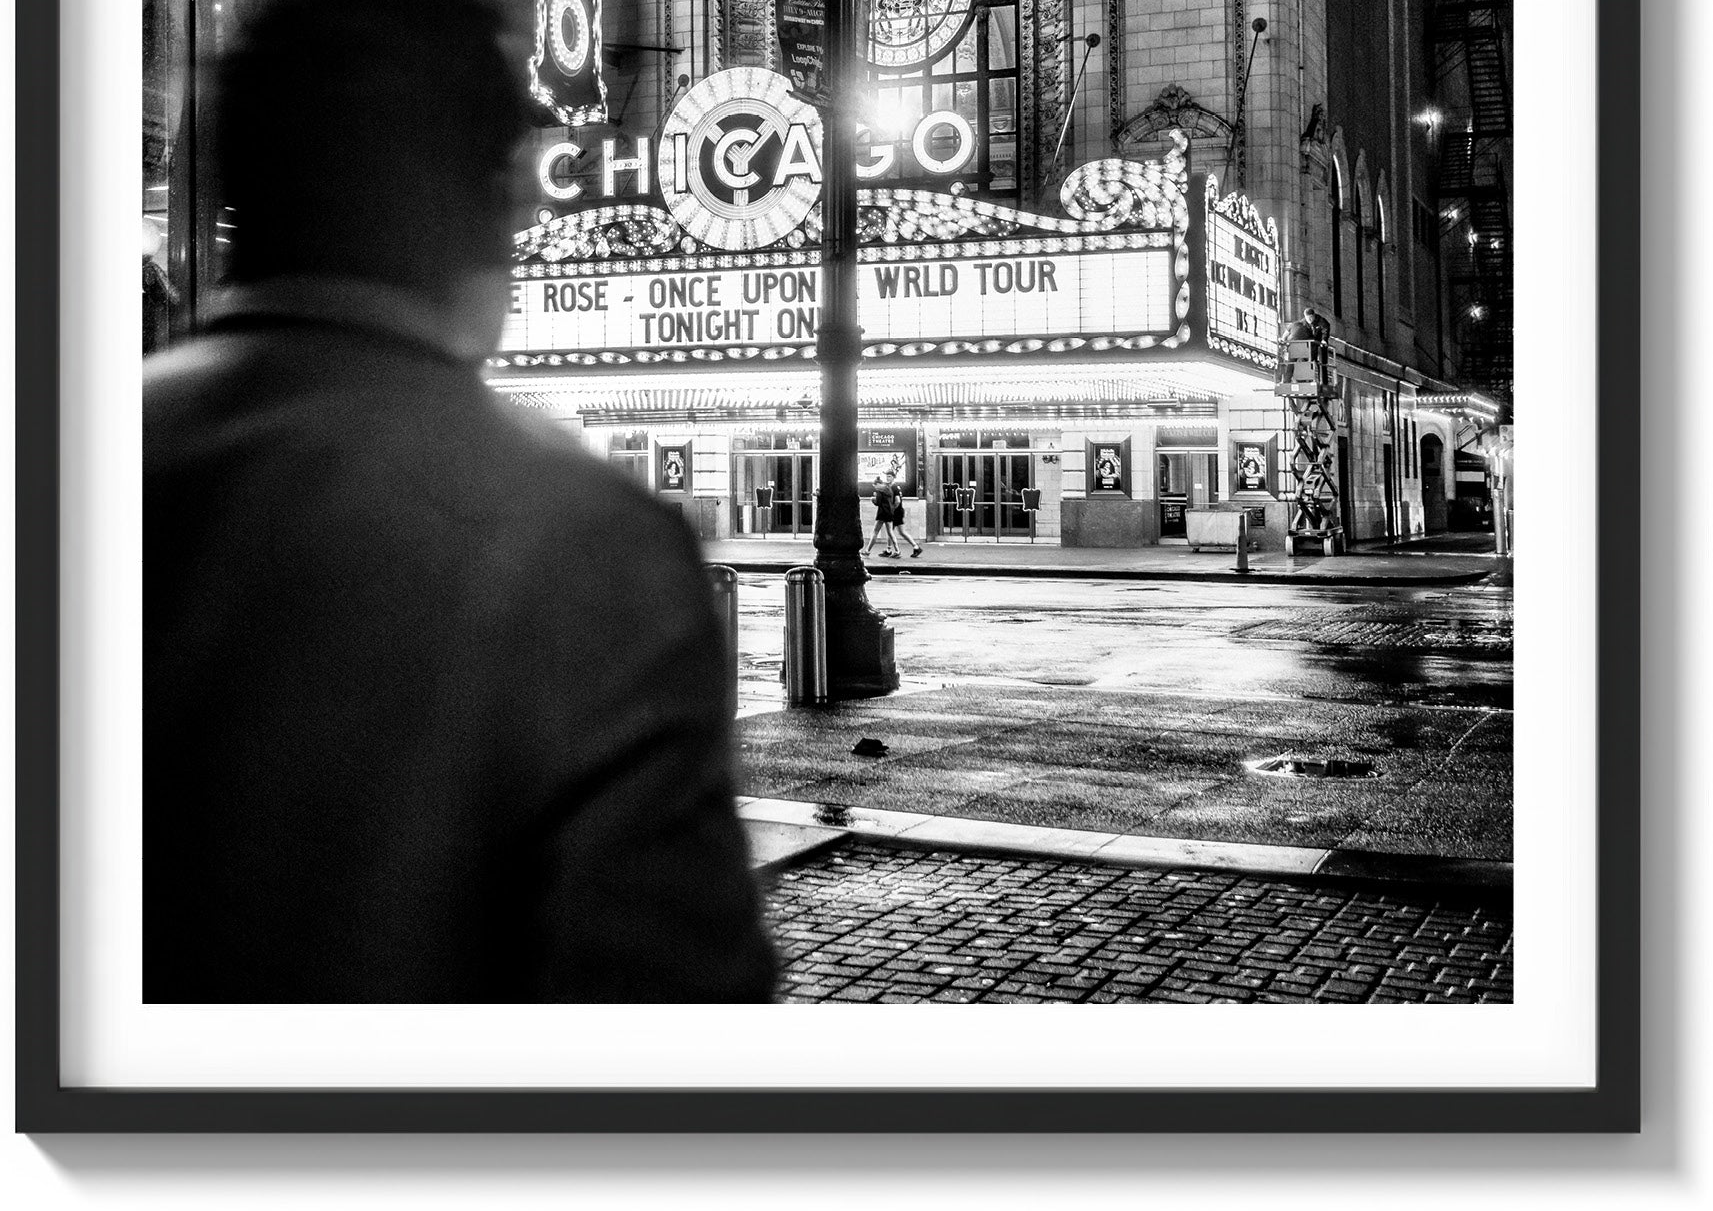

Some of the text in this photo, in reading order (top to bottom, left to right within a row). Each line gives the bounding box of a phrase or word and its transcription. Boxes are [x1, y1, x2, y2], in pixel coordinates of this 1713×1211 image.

[543, 280, 609, 313] ROSE
[648, 274, 722, 309] ONCE
[742, 270, 816, 306] UPON
[874, 263, 958, 300] WRLD
[973, 259, 1058, 295] TOUR
[639, 309, 760, 345] TONIGHT
